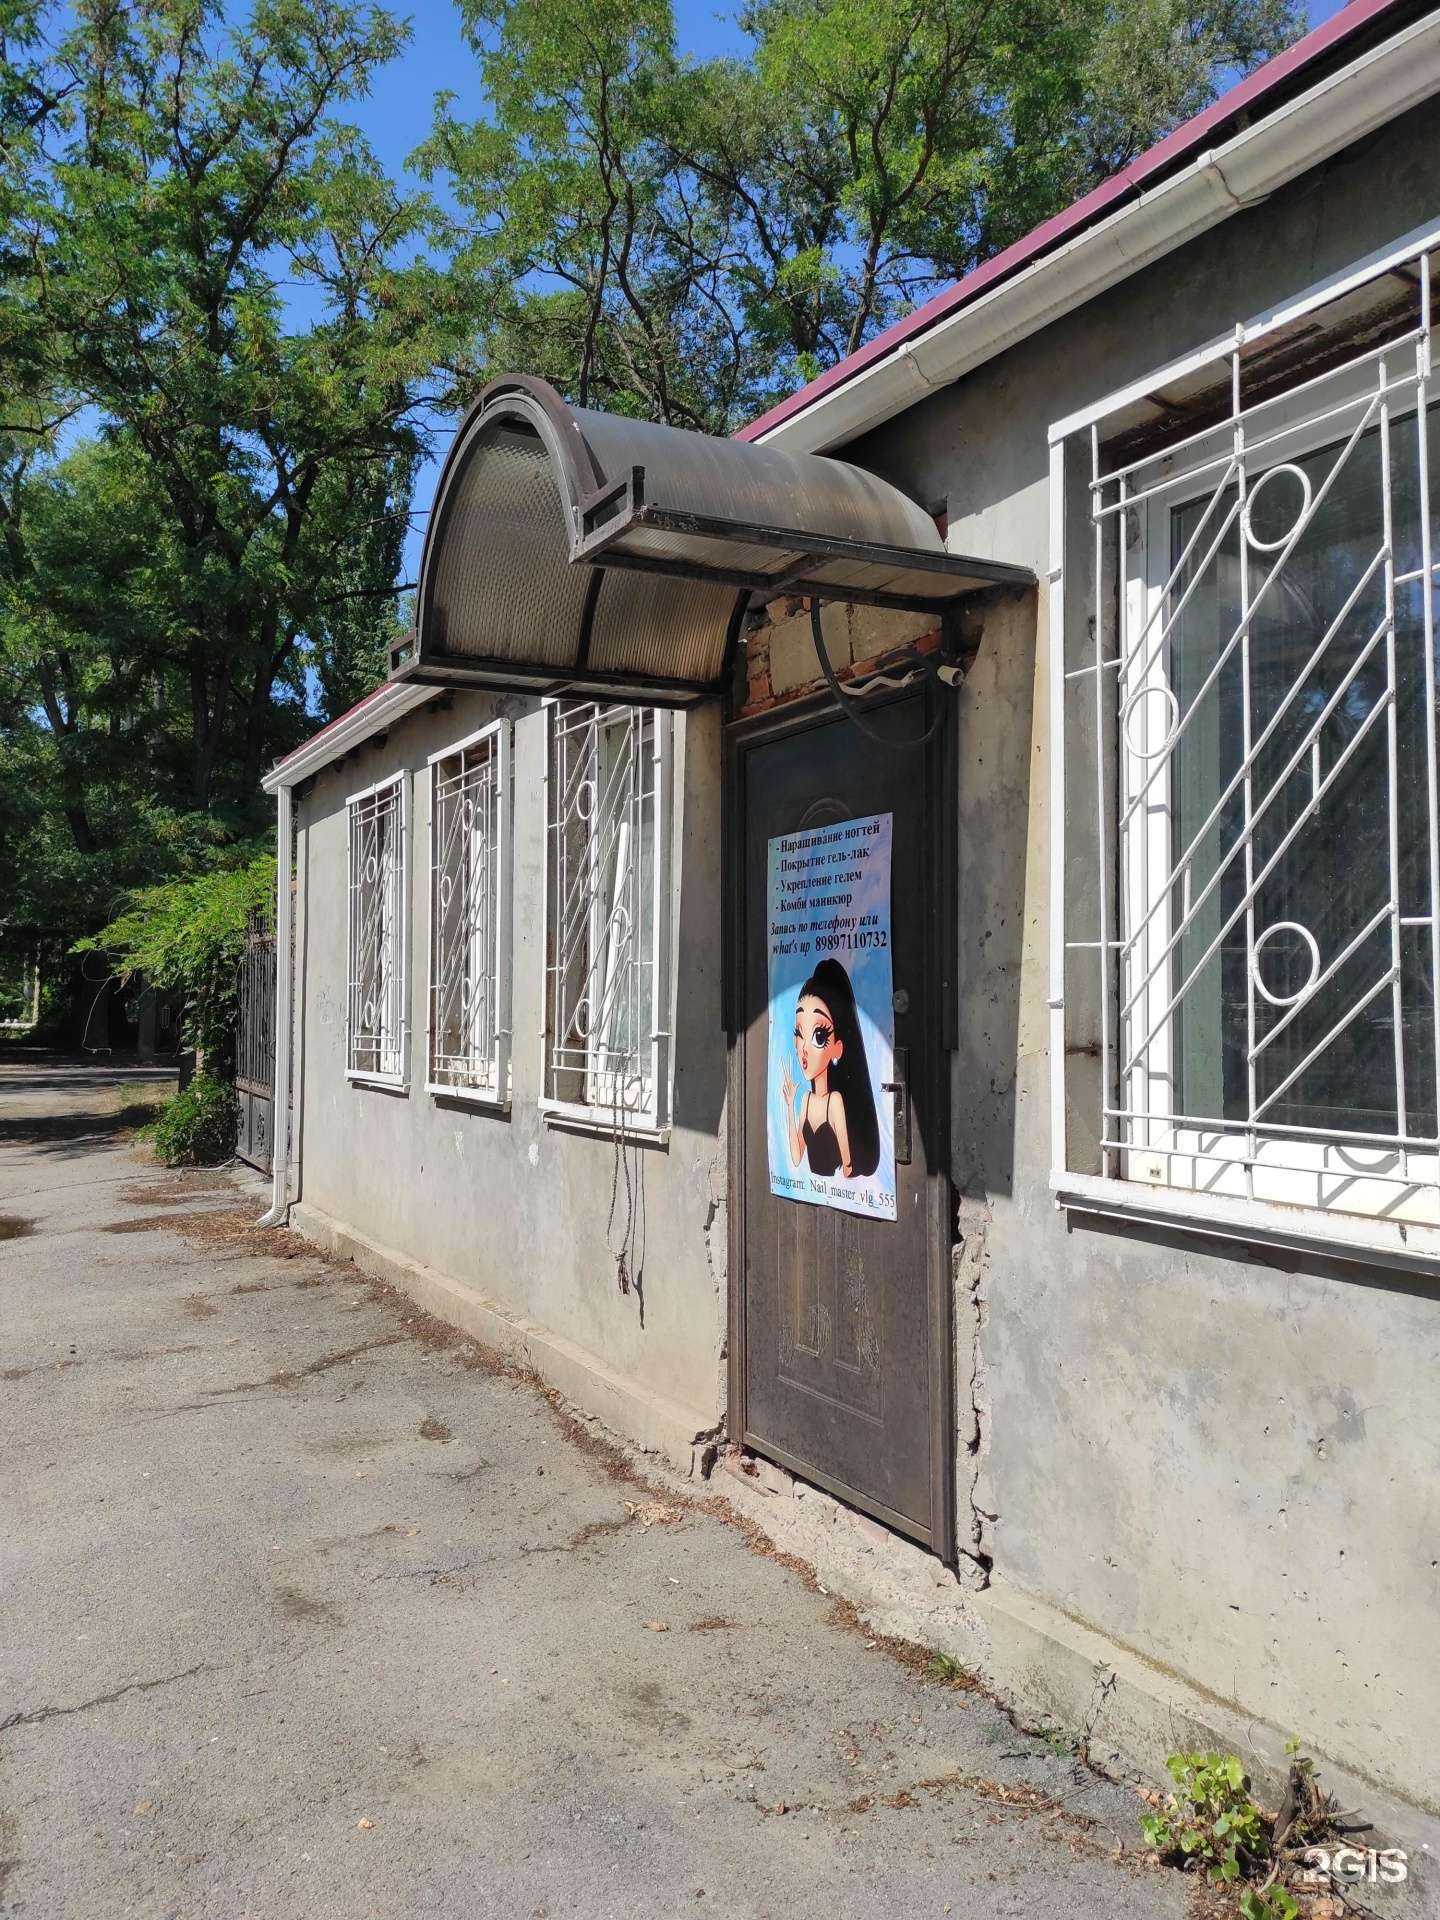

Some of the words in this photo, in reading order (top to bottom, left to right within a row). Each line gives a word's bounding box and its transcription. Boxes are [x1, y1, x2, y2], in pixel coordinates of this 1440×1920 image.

[834, 870, 863, 884] гелем
[780, 897, 807, 912] Комби
[809, 893, 852, 907] маникюр
[771, 922, 796, 935] Запись
[799, 922, 808, 932] по
[810, 915, 857, 932] телефону
[859, 914, 879, 926] или
[772, 940, 798, 954] what's
[800, 941, 811, 956] up
[815, 931, 887, 951] 89897110732
